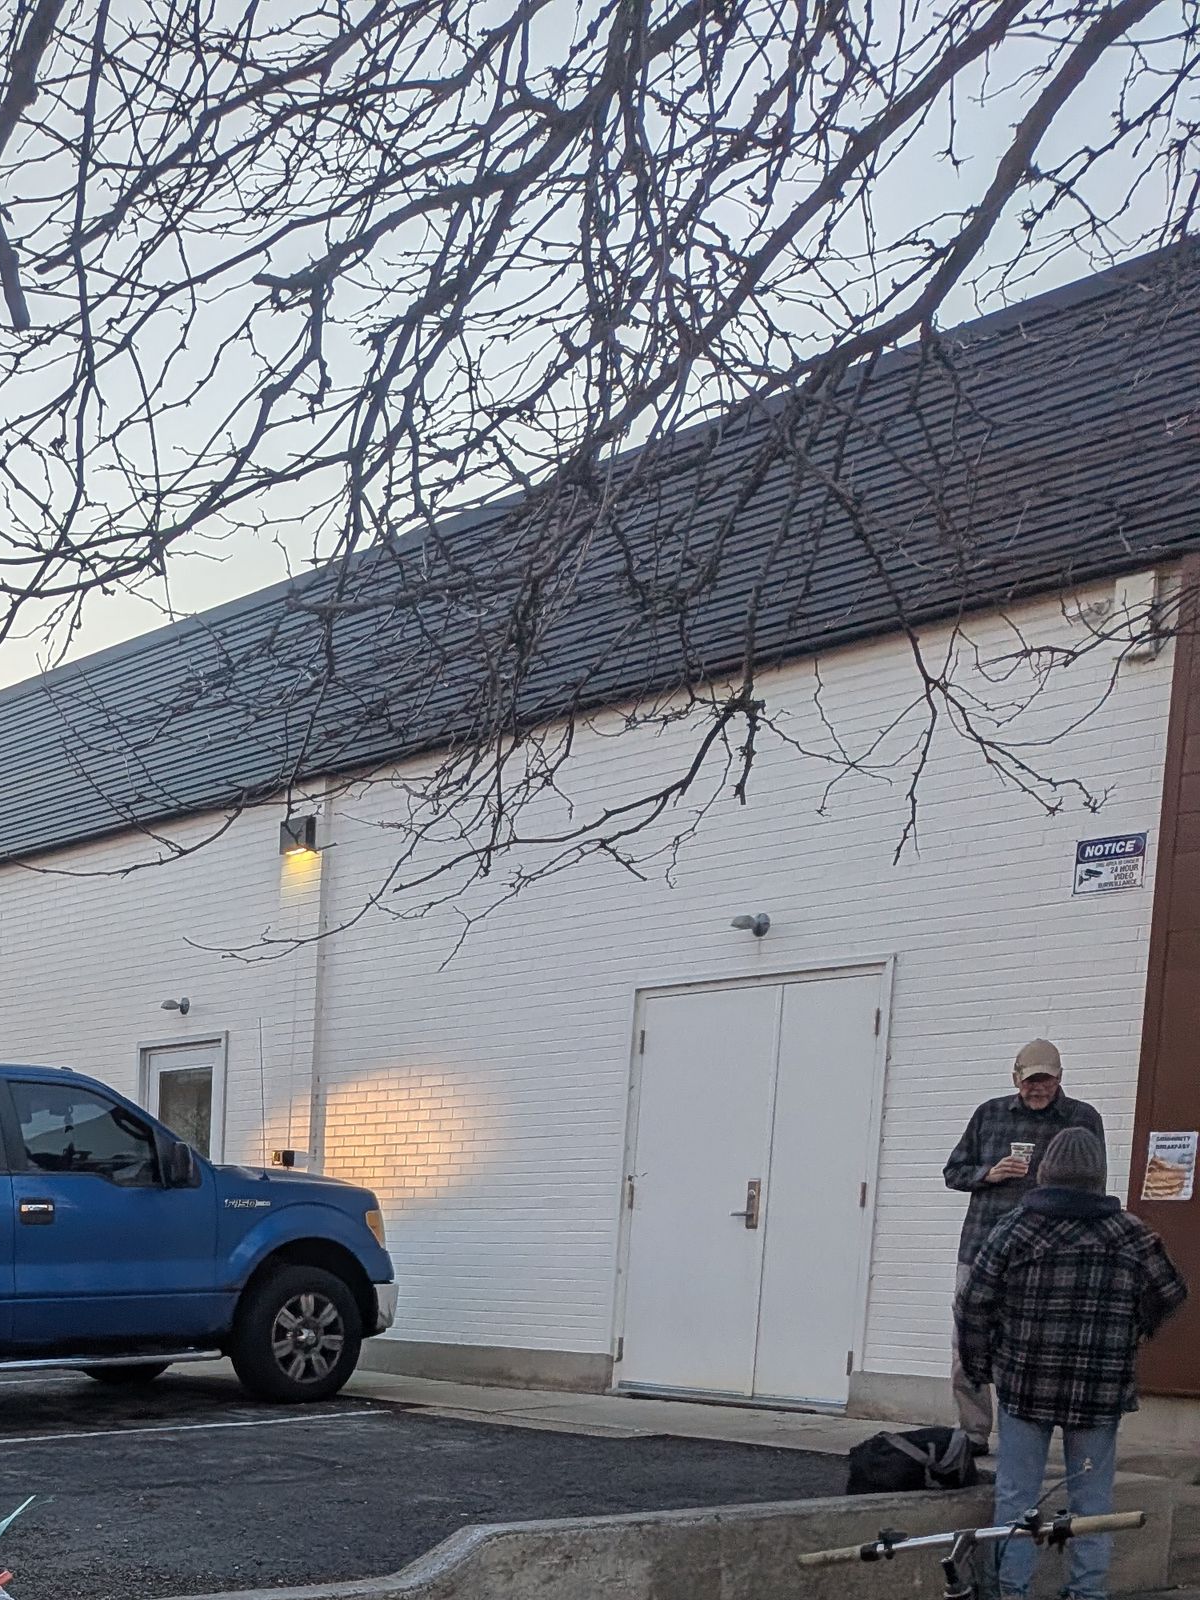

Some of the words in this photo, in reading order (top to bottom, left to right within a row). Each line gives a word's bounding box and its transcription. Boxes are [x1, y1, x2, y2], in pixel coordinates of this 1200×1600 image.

[1084, 840, 1136, 857] NOTICE
[1120, 864, 1138, 872] HOUR
[1113, 872, 1133, 880] VIDEO
